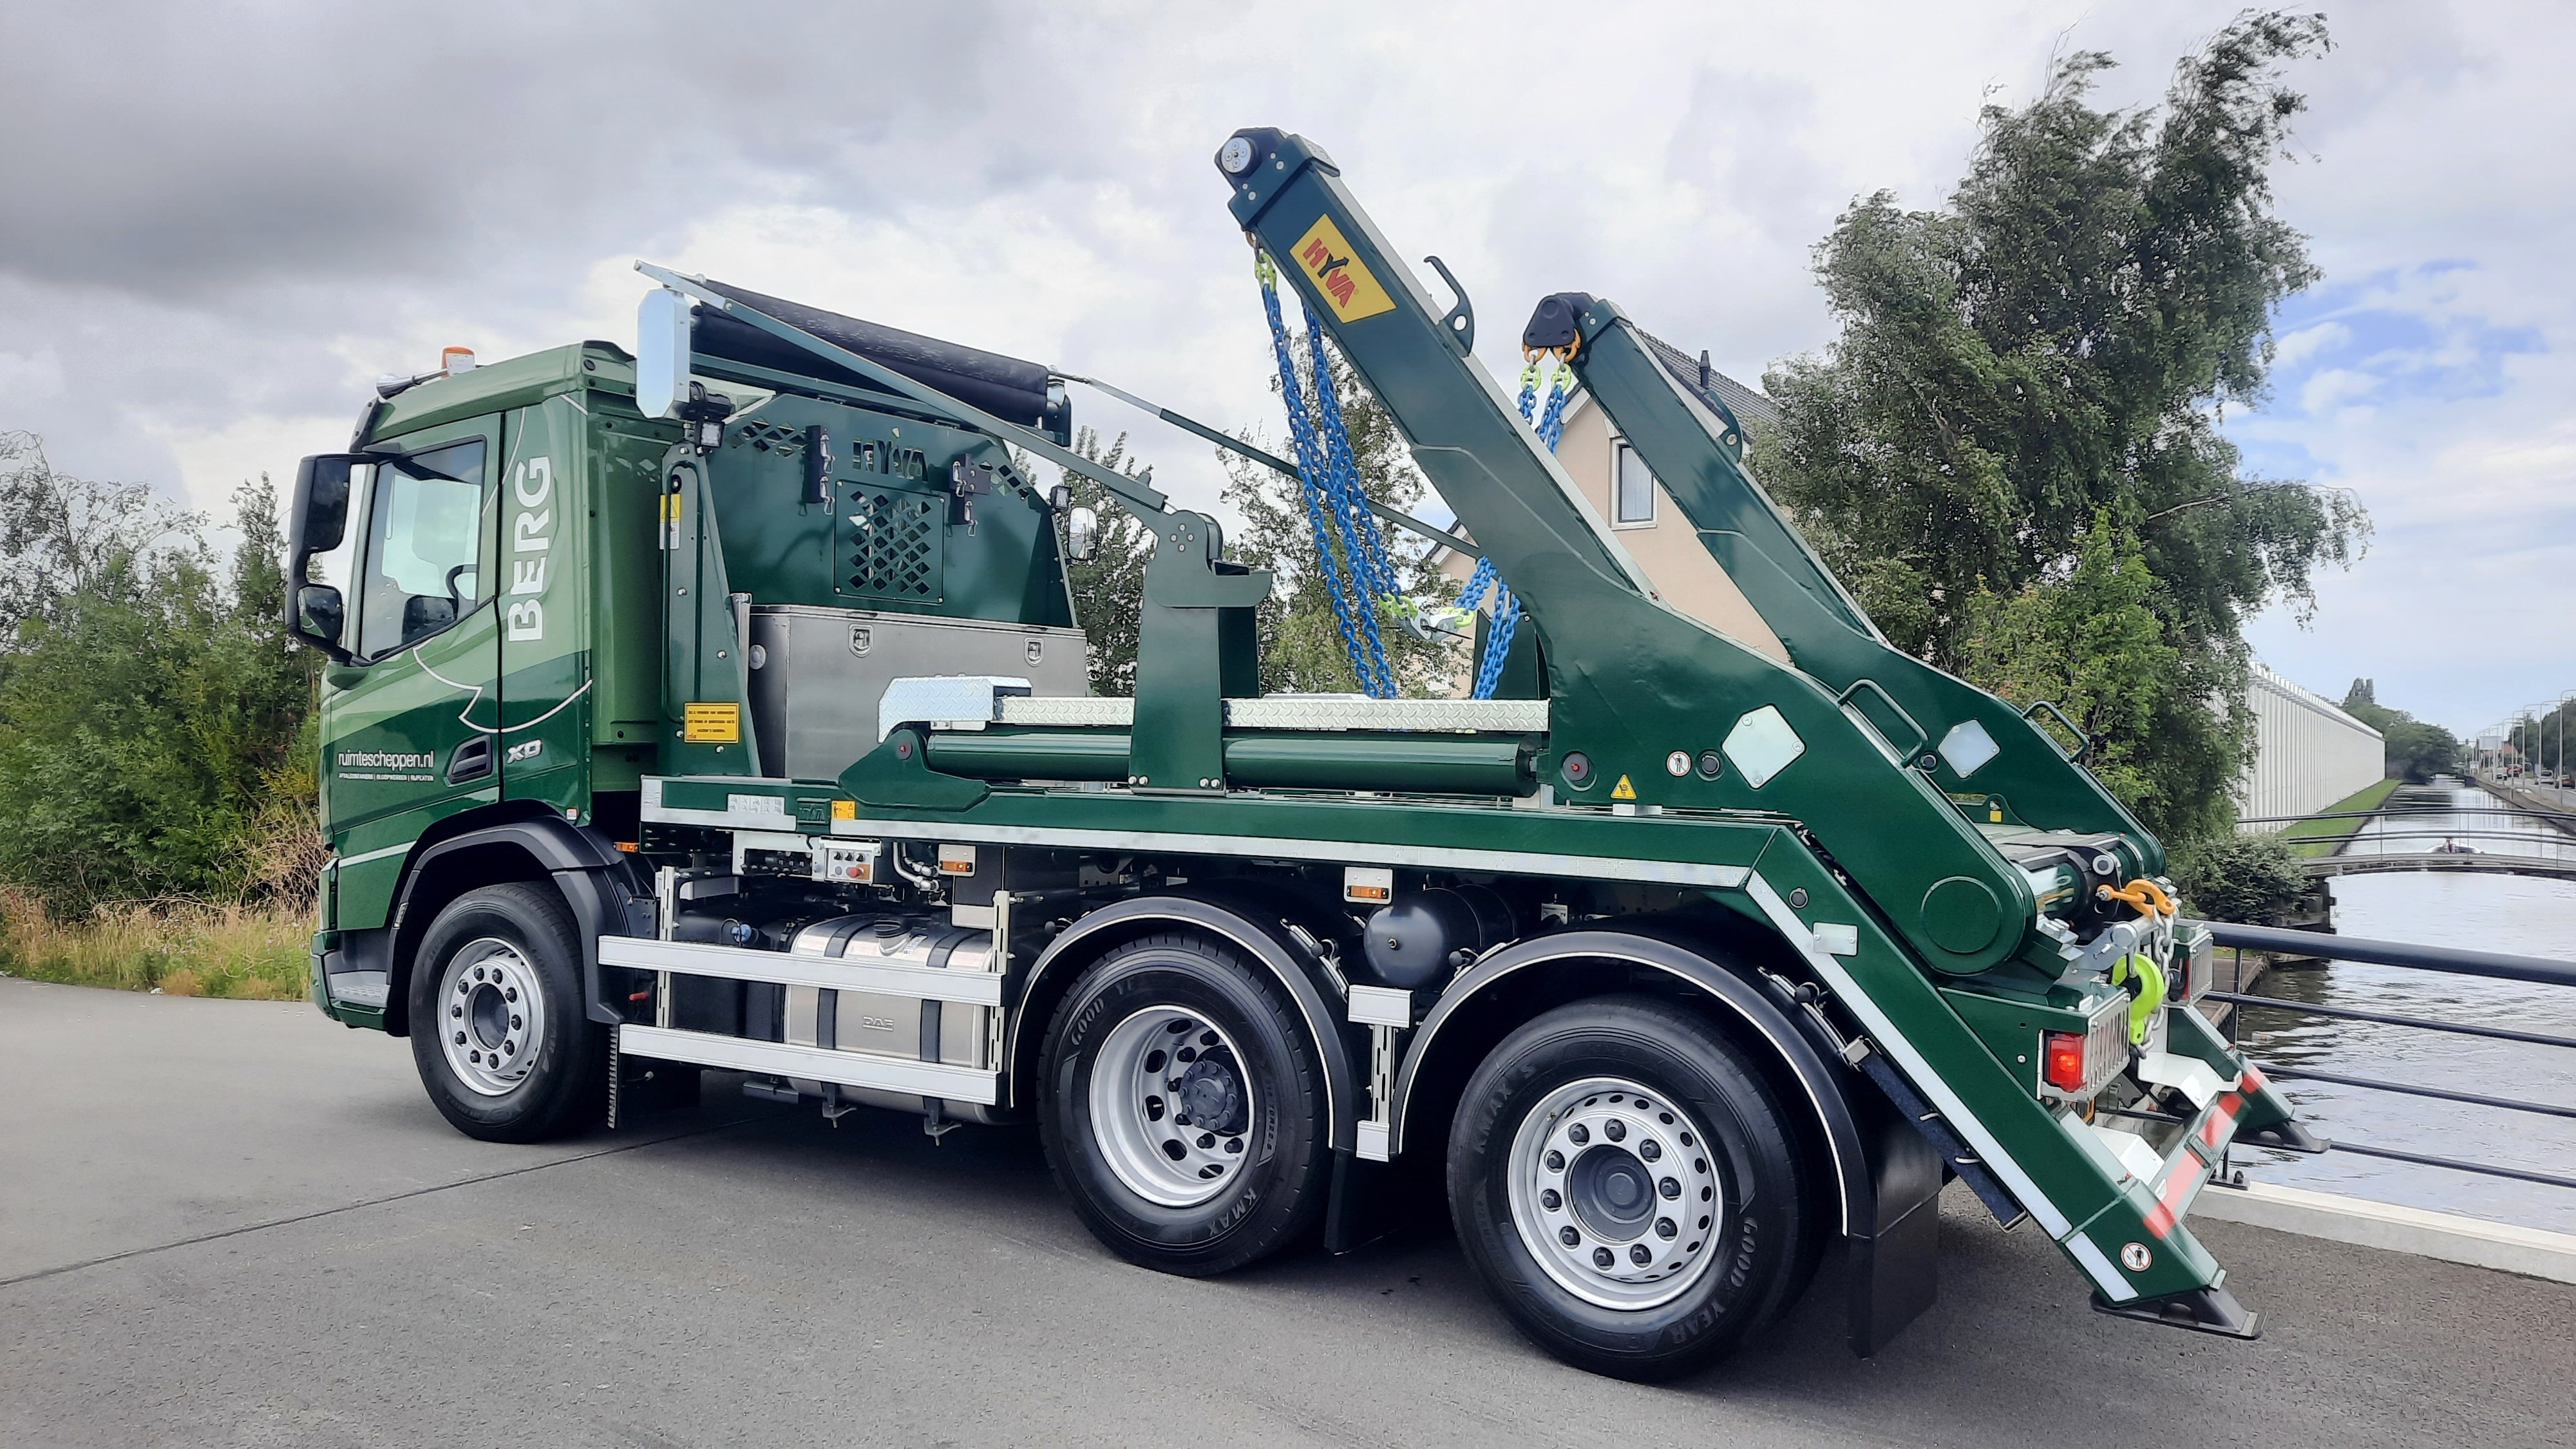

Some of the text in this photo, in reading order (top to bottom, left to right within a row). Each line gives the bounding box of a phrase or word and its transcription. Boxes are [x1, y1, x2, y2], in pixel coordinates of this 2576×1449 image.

[1303, 238, 1356, 308] HYVA
[507, 456, 551, 641] BERG
[338, 749, 434, 771] ruimtescheppen.nl
[507, 739, 542, 764] XD
[1071, 998, 1104, 1045] GOOD
[1207, 1187, 1256, 1236] KMAX
[1669, 1217, 1758, 1344] GOOD YEAR
